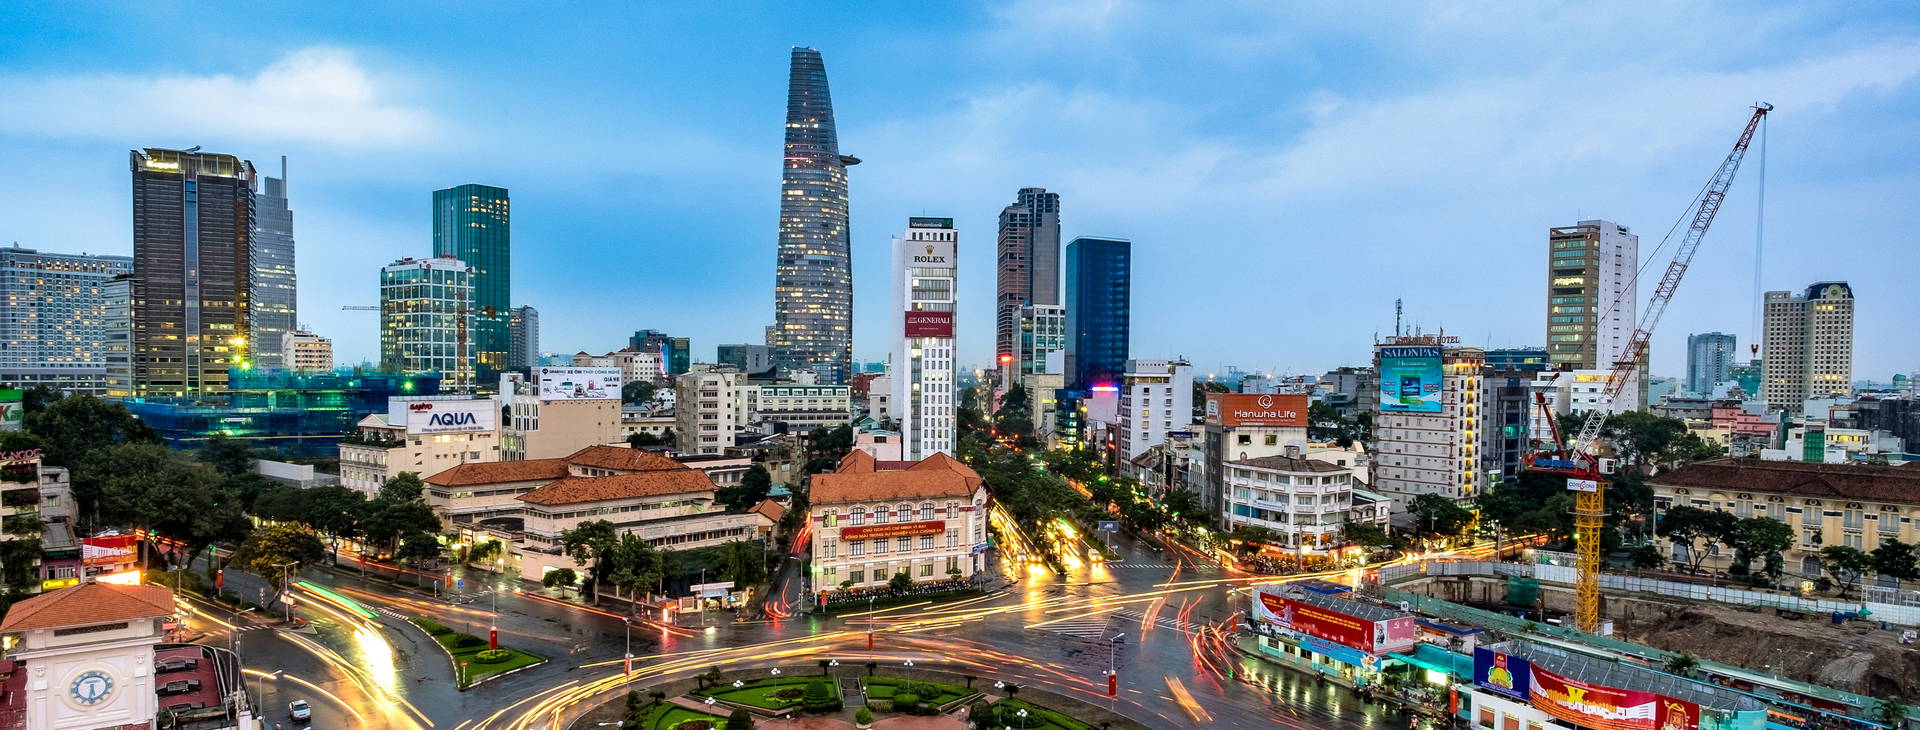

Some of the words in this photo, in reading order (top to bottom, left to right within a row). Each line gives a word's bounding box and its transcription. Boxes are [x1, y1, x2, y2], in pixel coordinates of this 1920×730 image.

[914, 255, 945, 263] ROLEX
[917, 316, 950, 324] GENERALI
[1384, 348, 1441, 358] SALONPAS
[409, 402, 433, 411] SANYO
[1234, 410, 1276, 418] Hanwha
[1277, 410, 1296, 418] Life
[429, 412, 477, 426] AQUA
